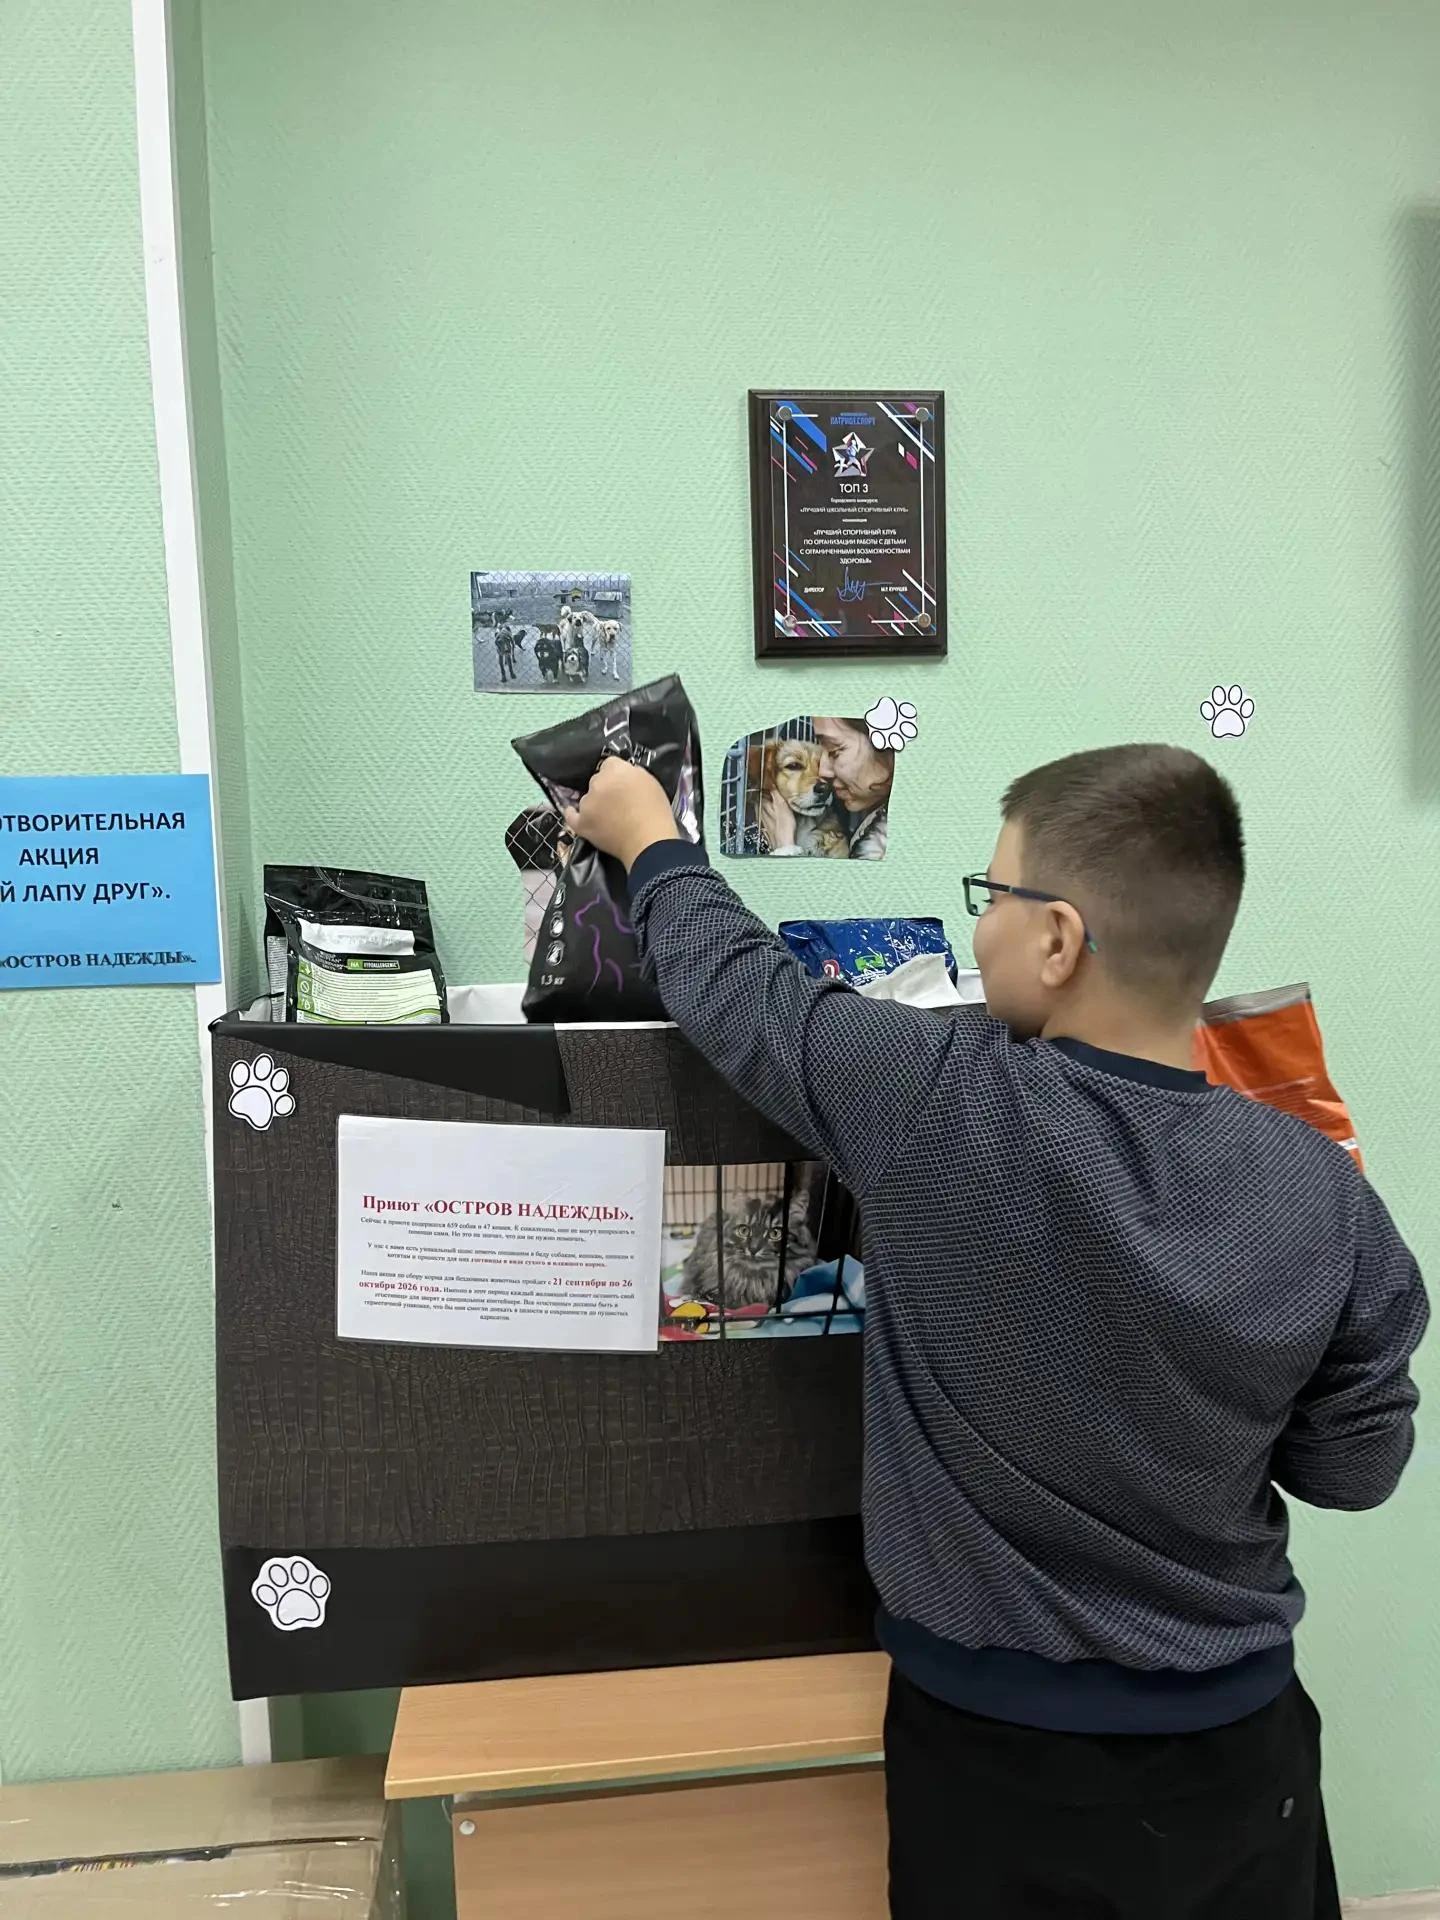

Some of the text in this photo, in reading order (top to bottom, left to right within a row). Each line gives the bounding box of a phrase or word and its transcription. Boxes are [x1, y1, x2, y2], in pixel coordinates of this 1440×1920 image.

[840, 483, 870, 493] ТОП 3
[0, 811, 186, 832] ТВОРИТЕЛЬНАЯ
[19, 847, 99, 869] АКЦИЯ
[22, 884, 87, 902] ЛАПУ
[93, 882, 171, 905] ДРУГ».
[0, 951, 197, 969] «ОСТРОВ НАДЕЖДЫ».
[363, 1195, 634, 1222] Приют «ОСТРОВ НАДЕЖДЫ».
[358, 1279, 397, 1292] октября
[398, 1281, 418, 1291] 2026
[552, 1276, 562, 1285] 21
[565, 1276, 606, 1289] сентября
[622, 1279, 633, 1288] 26
